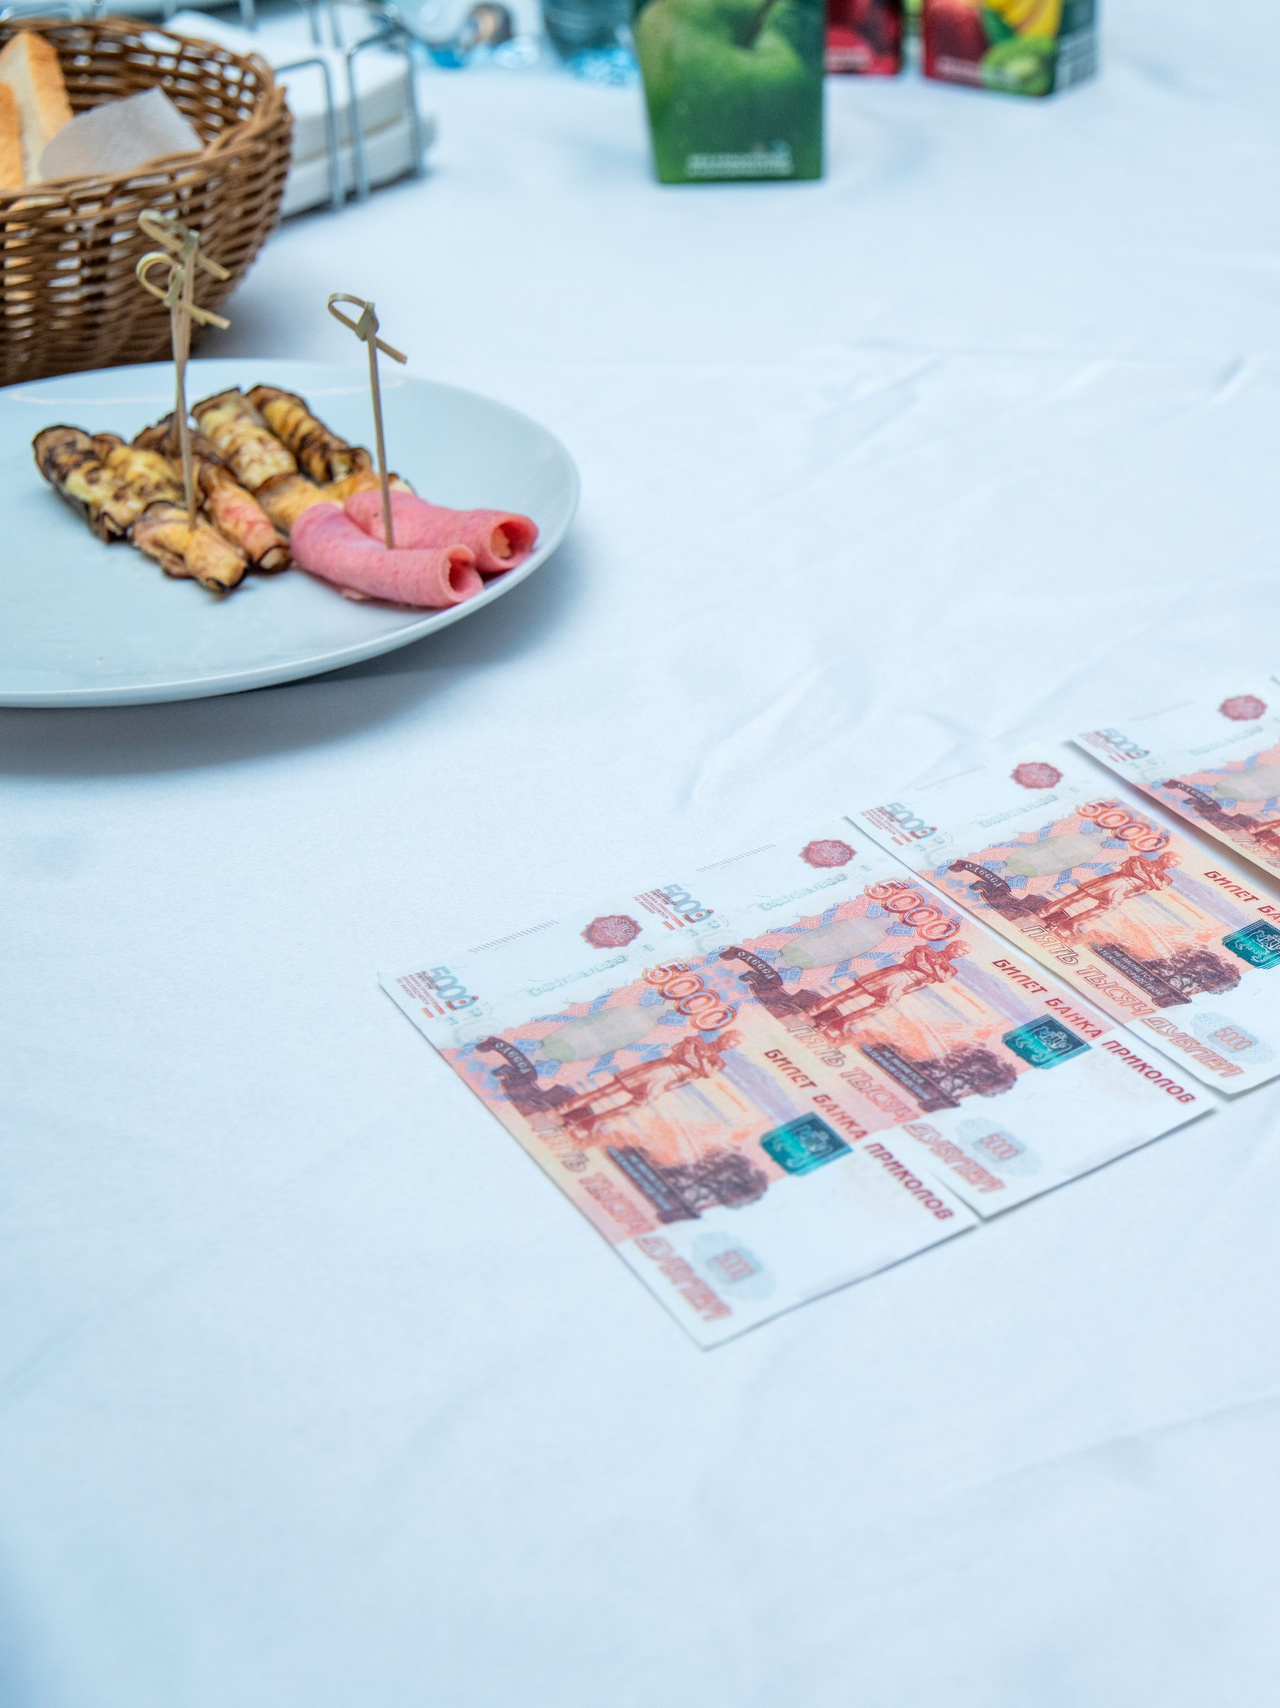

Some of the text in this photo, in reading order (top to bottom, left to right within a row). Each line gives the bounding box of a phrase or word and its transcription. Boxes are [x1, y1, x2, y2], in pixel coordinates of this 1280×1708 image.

[887, 802, 936, 839] 5000
[1074, 797, 1168, 852] 5000
[663, 884, 712, 922] 5000
[863, 878, 959, 941] 5000
[1202, 869, 1260, 903] БИЛЕТ
[430, 966, 477, 1010] 5000
[642, 959, 737, 1032] 5000
[1017, 924, 1247, 1081] ПЯТЬ ТЫСЯЧ ДУБЛЕЙ
[990, 958, 1196, 1104] БИЛЕТ БАНКА ПРИКОЛОВ
[1213, 1025, 1253, 1052] 5000
[786, 1022, 853, 1068] ПЯТЬ
[837, 1065, 921, 1125] ТЫСЯЧ
[762, 1047, 955, 1221] БИЛЕТ БАНКА ПРИКОЛОВ
[976, 1133, 1020, 1161] 5000
